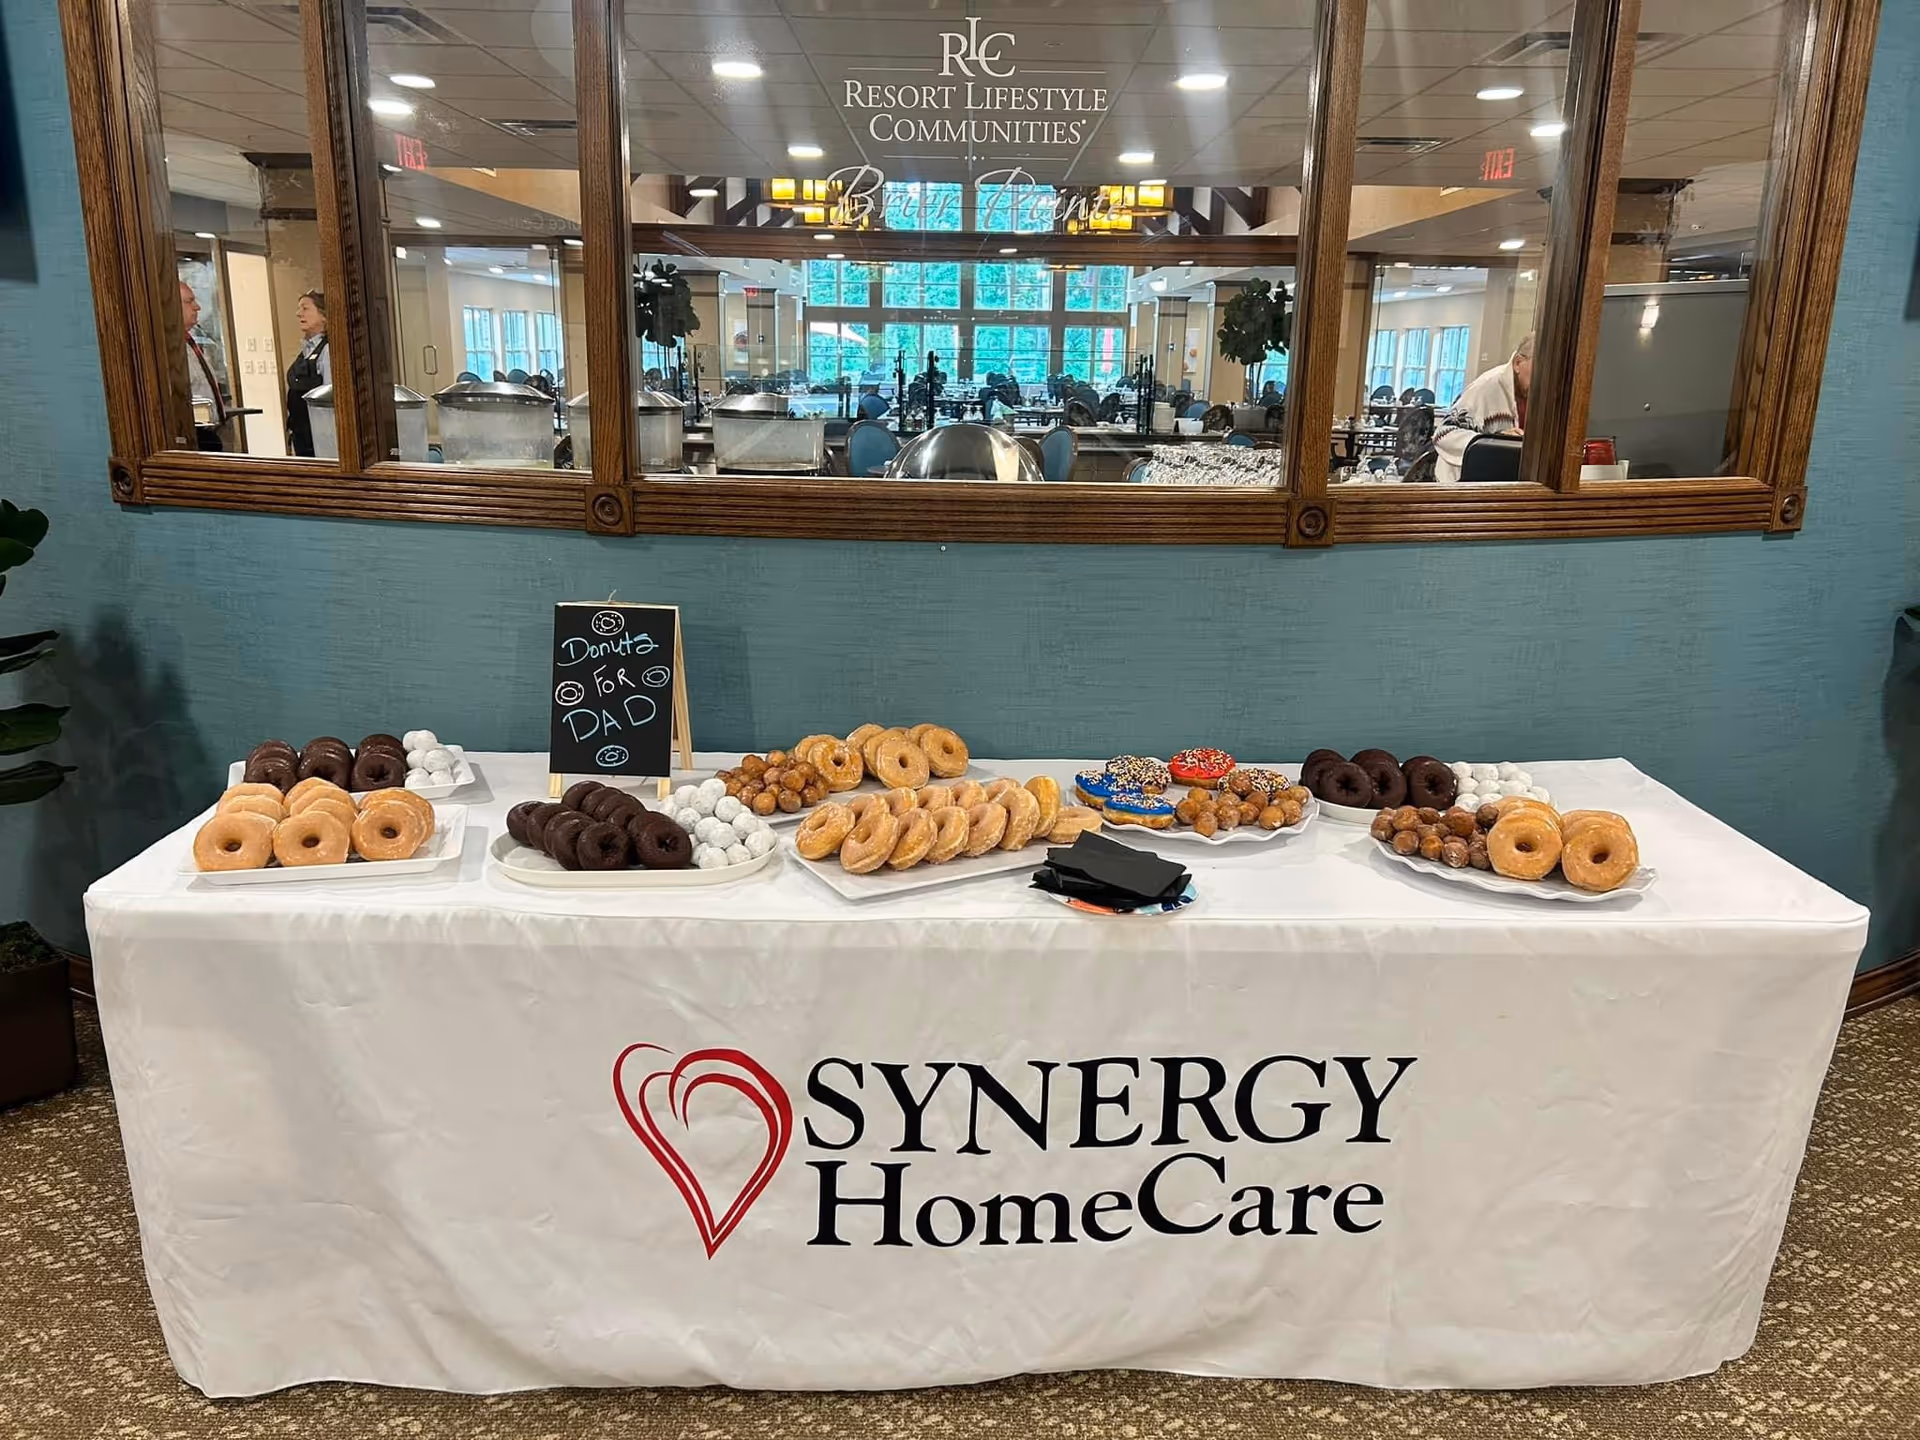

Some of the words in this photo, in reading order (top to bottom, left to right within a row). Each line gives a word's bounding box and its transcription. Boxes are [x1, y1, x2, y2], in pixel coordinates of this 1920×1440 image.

[843, 79, 956, 110] RESORT
[964, 81, 1108, 112] LIFESTYLE
[557, 631, 659, 667] Donuts
[562, 694, 656, 743] DAD
[803, 1055, 1418, 1154] SYNERGY
[806, 1152, 1384, 1248] HomeCare
